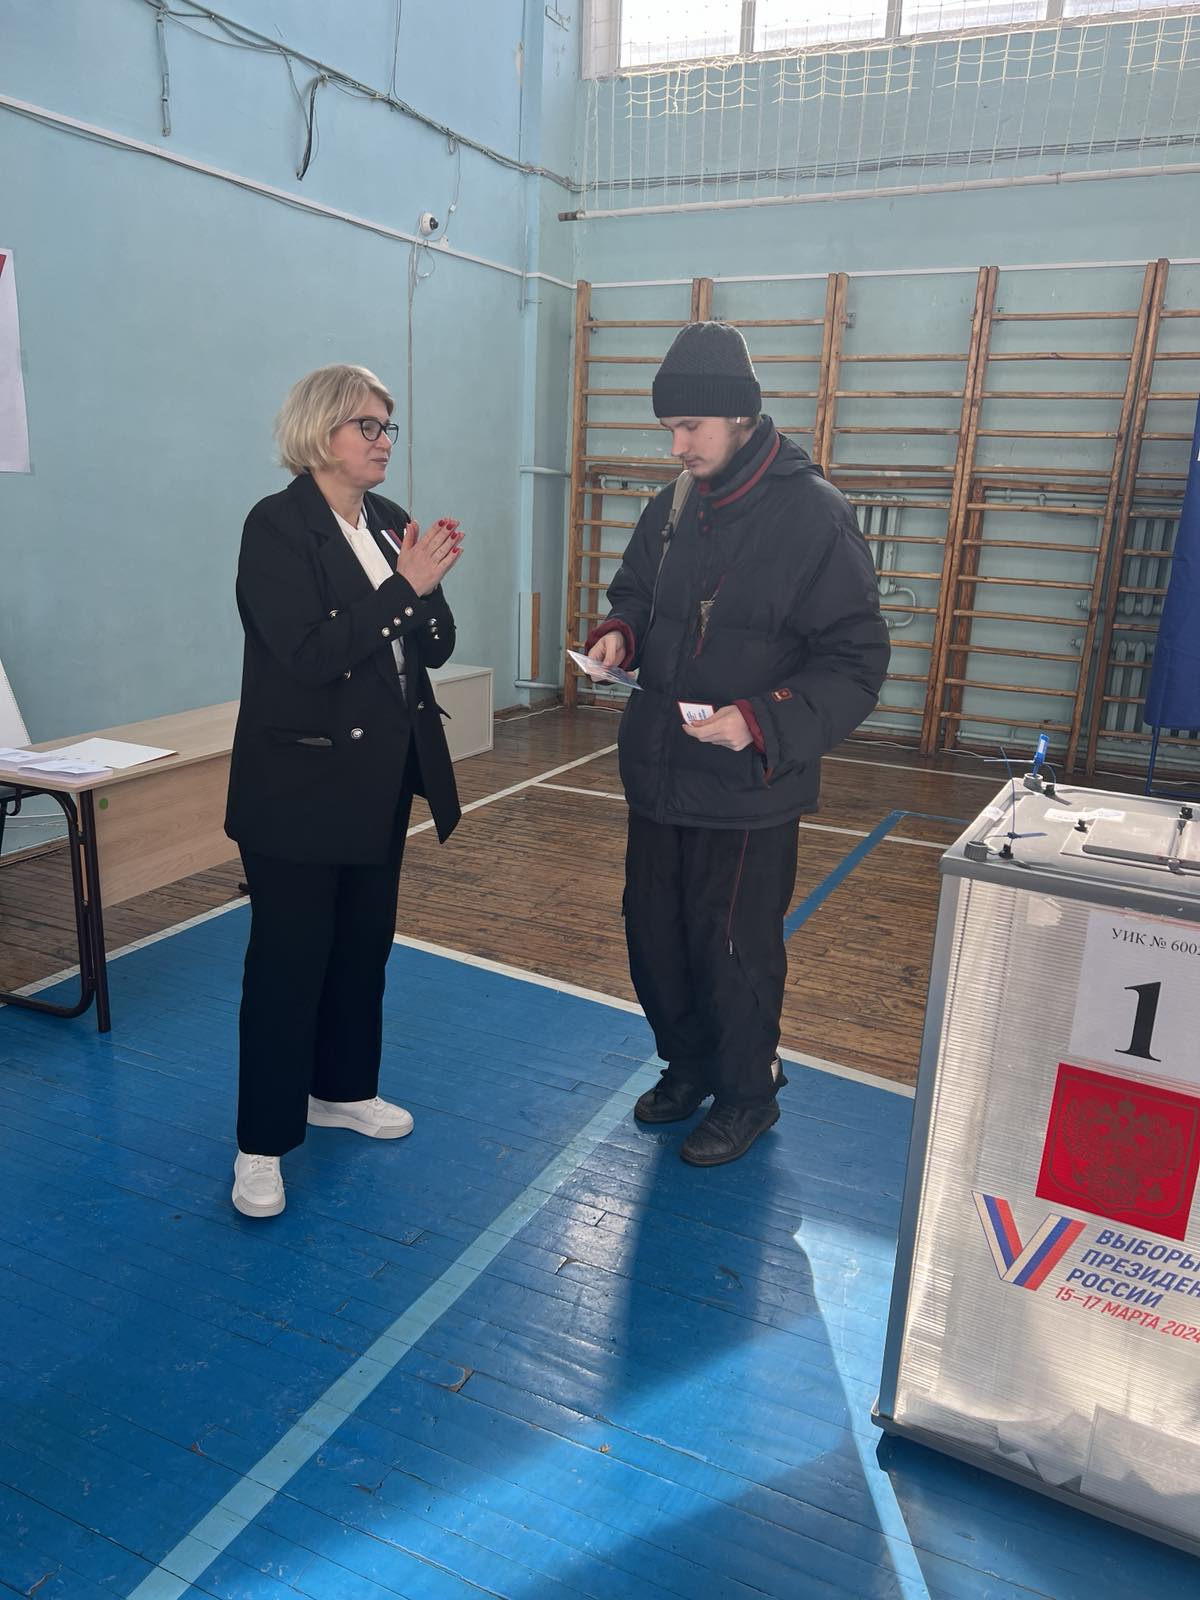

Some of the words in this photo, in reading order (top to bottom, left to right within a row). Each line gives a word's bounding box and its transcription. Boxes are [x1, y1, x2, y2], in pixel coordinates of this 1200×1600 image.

[1112, 927, 1147, 946] УИК
[1149, 935, 1167, 950] №
[1114, 981, 1162, 1062] 1
[1065, 1267, 1164, 1309] РОССИИ
[1100, 1300, 1161, 1330] МАРТА
[1160, 1319, 1200, 1343] 2024
